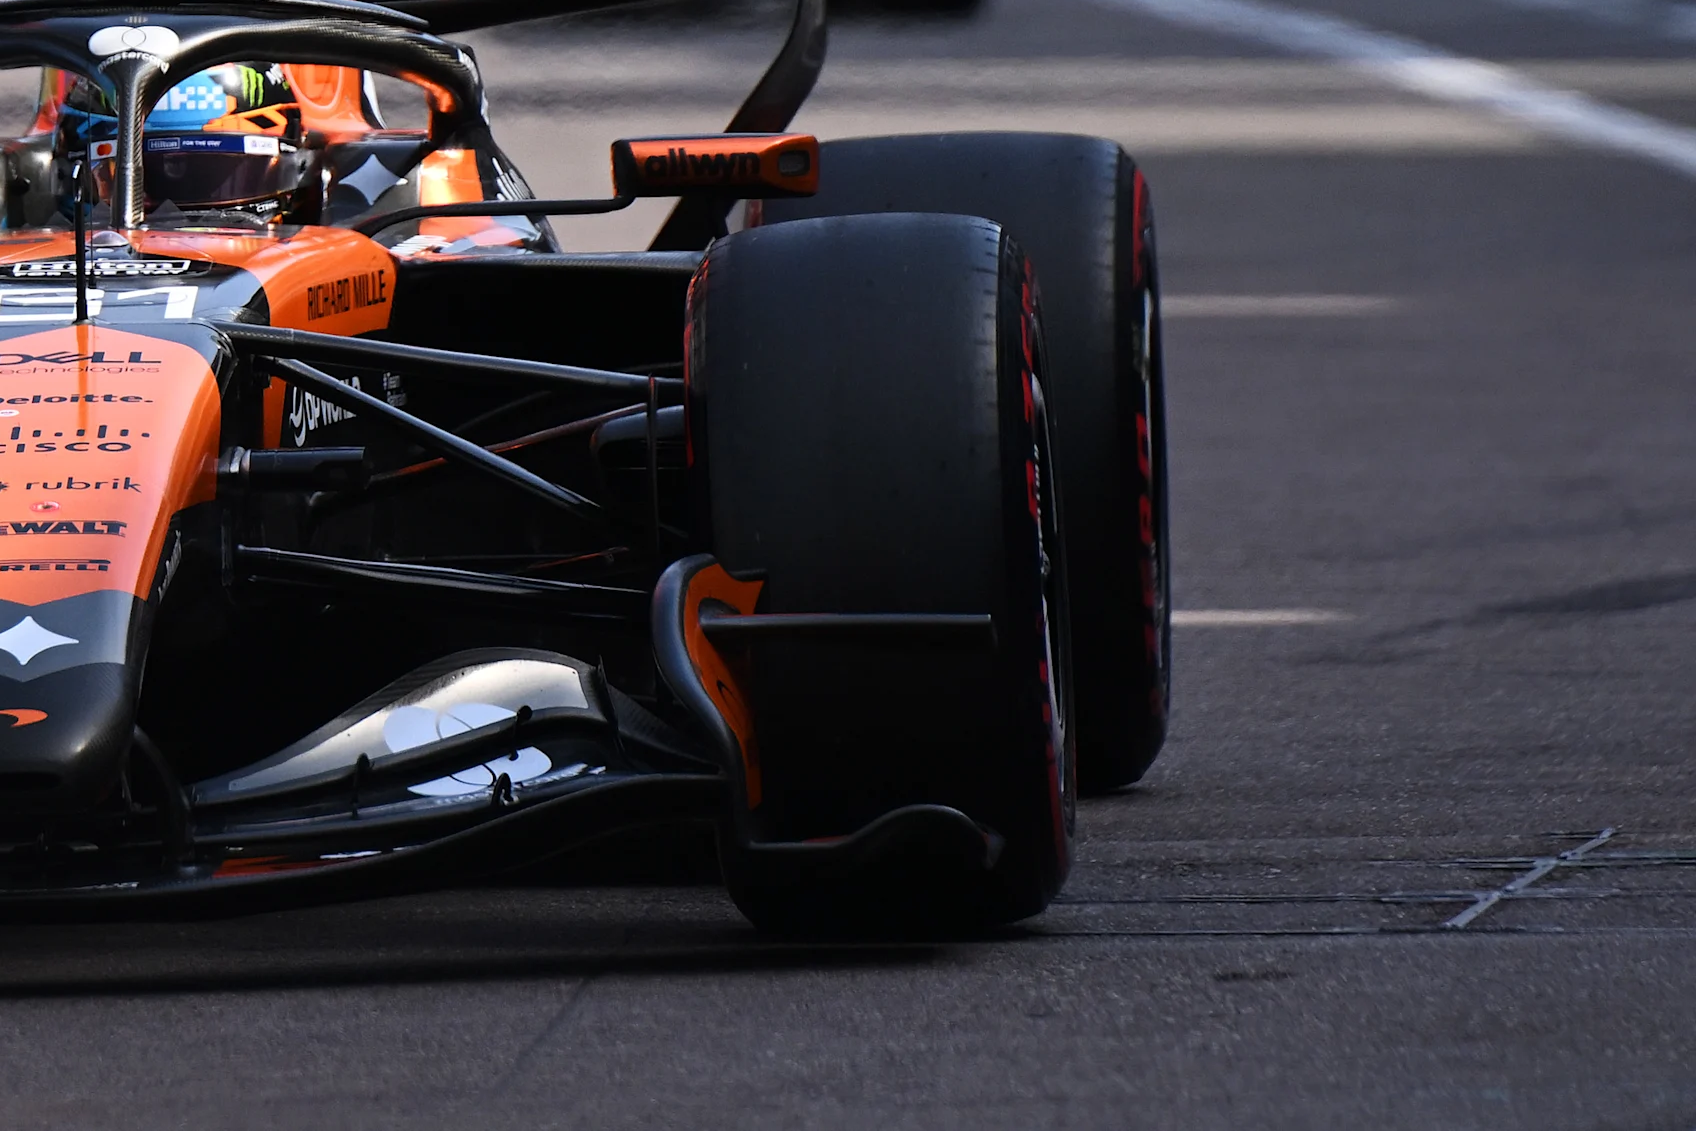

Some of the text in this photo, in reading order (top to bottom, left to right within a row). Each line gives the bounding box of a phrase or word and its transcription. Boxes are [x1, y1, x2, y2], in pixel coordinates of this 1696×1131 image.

[645, 147, 760, 181] allwyn
[308, 269, 386, 321] RICHARD MILLE
[26, 477, 142, 492] rubrik
